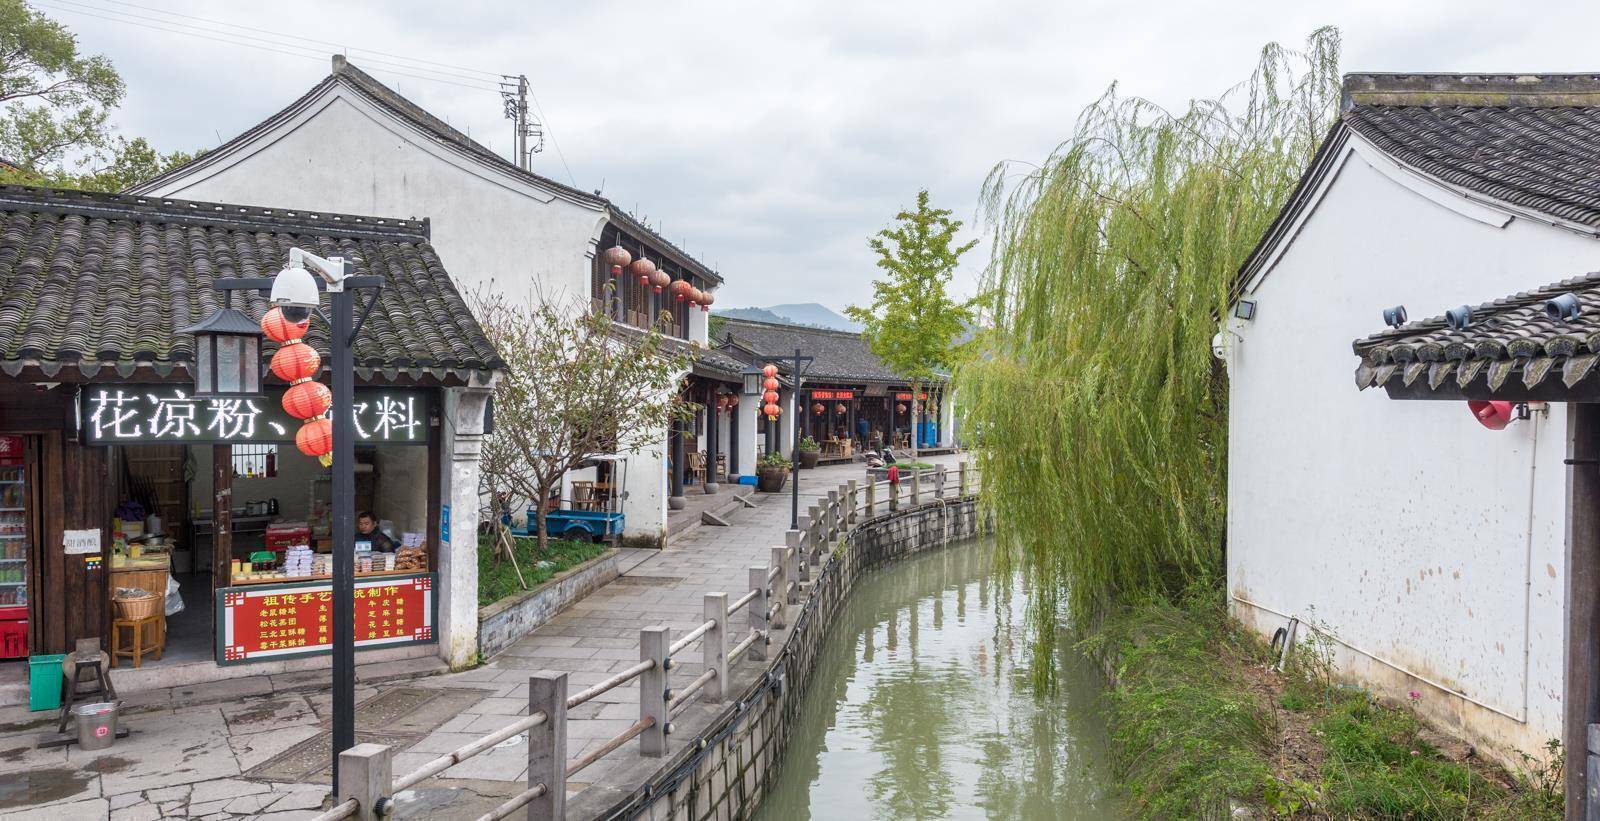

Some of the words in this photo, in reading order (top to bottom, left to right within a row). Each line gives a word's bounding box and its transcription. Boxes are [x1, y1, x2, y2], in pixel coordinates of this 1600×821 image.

[263, 586, 399, 606] 祖传手艺统制作
